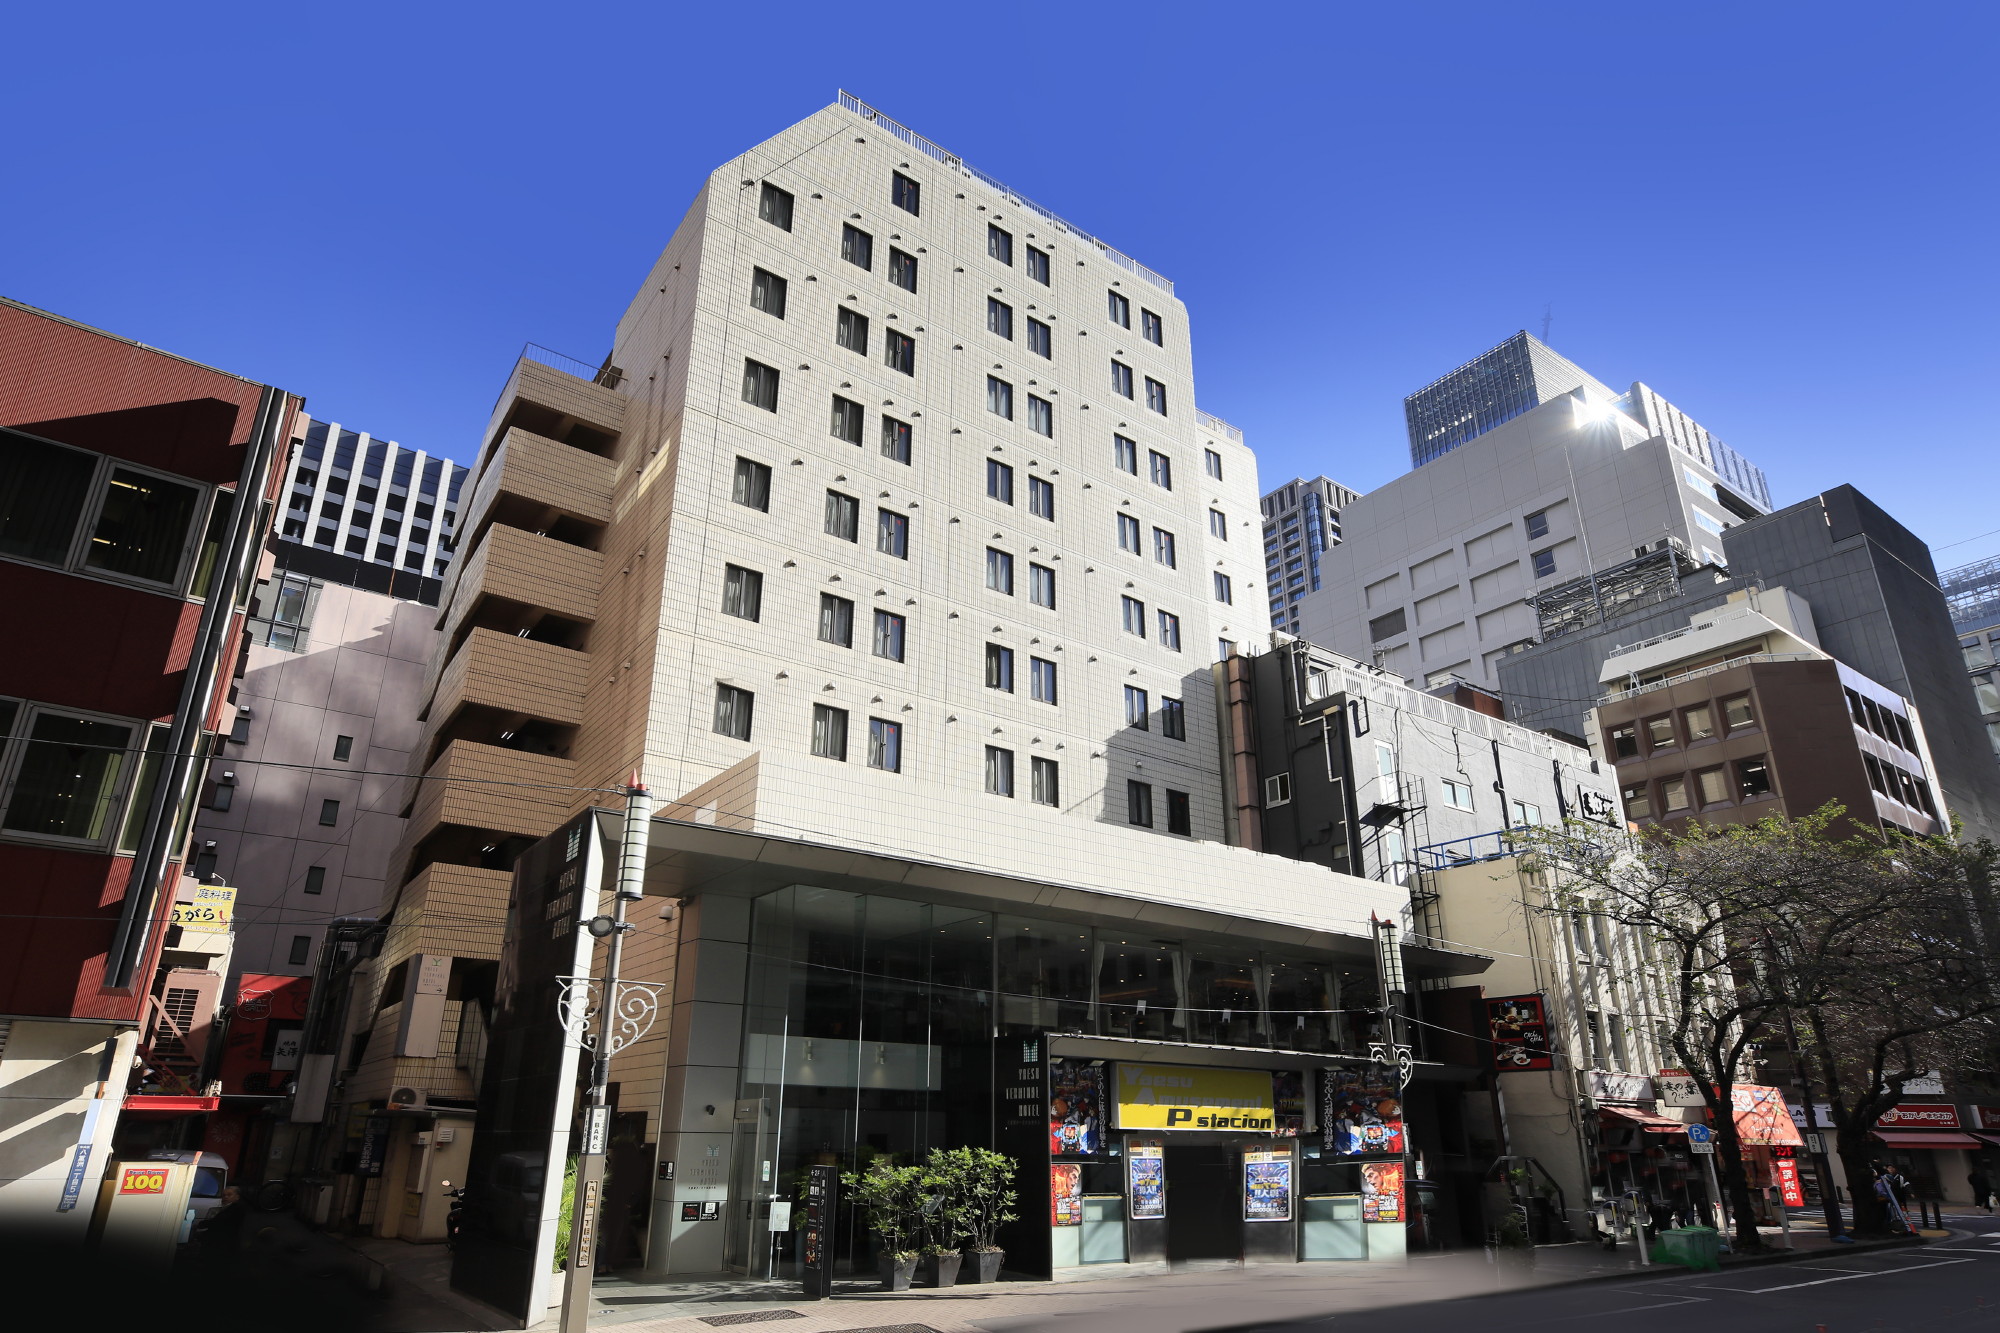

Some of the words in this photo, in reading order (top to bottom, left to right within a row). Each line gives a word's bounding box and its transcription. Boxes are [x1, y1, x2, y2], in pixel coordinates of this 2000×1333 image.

[1018, 1067, 1040, 1081] YAESU
[1122, 1066, 1193, 1088] Yaesu
[1006, 1086, 1040, 1100] TERMINAL
[1134, 1087, 1263, 1108] Amusement
[1018, 1104, 1040, 1117] HOTEL
[1166, 1108, 1193, 1126] P
[1196, 1113, 1272, 1129] stacion
[1692, 1127, 1701, 1140] P
[123, 1174, 163, 1190] 100
